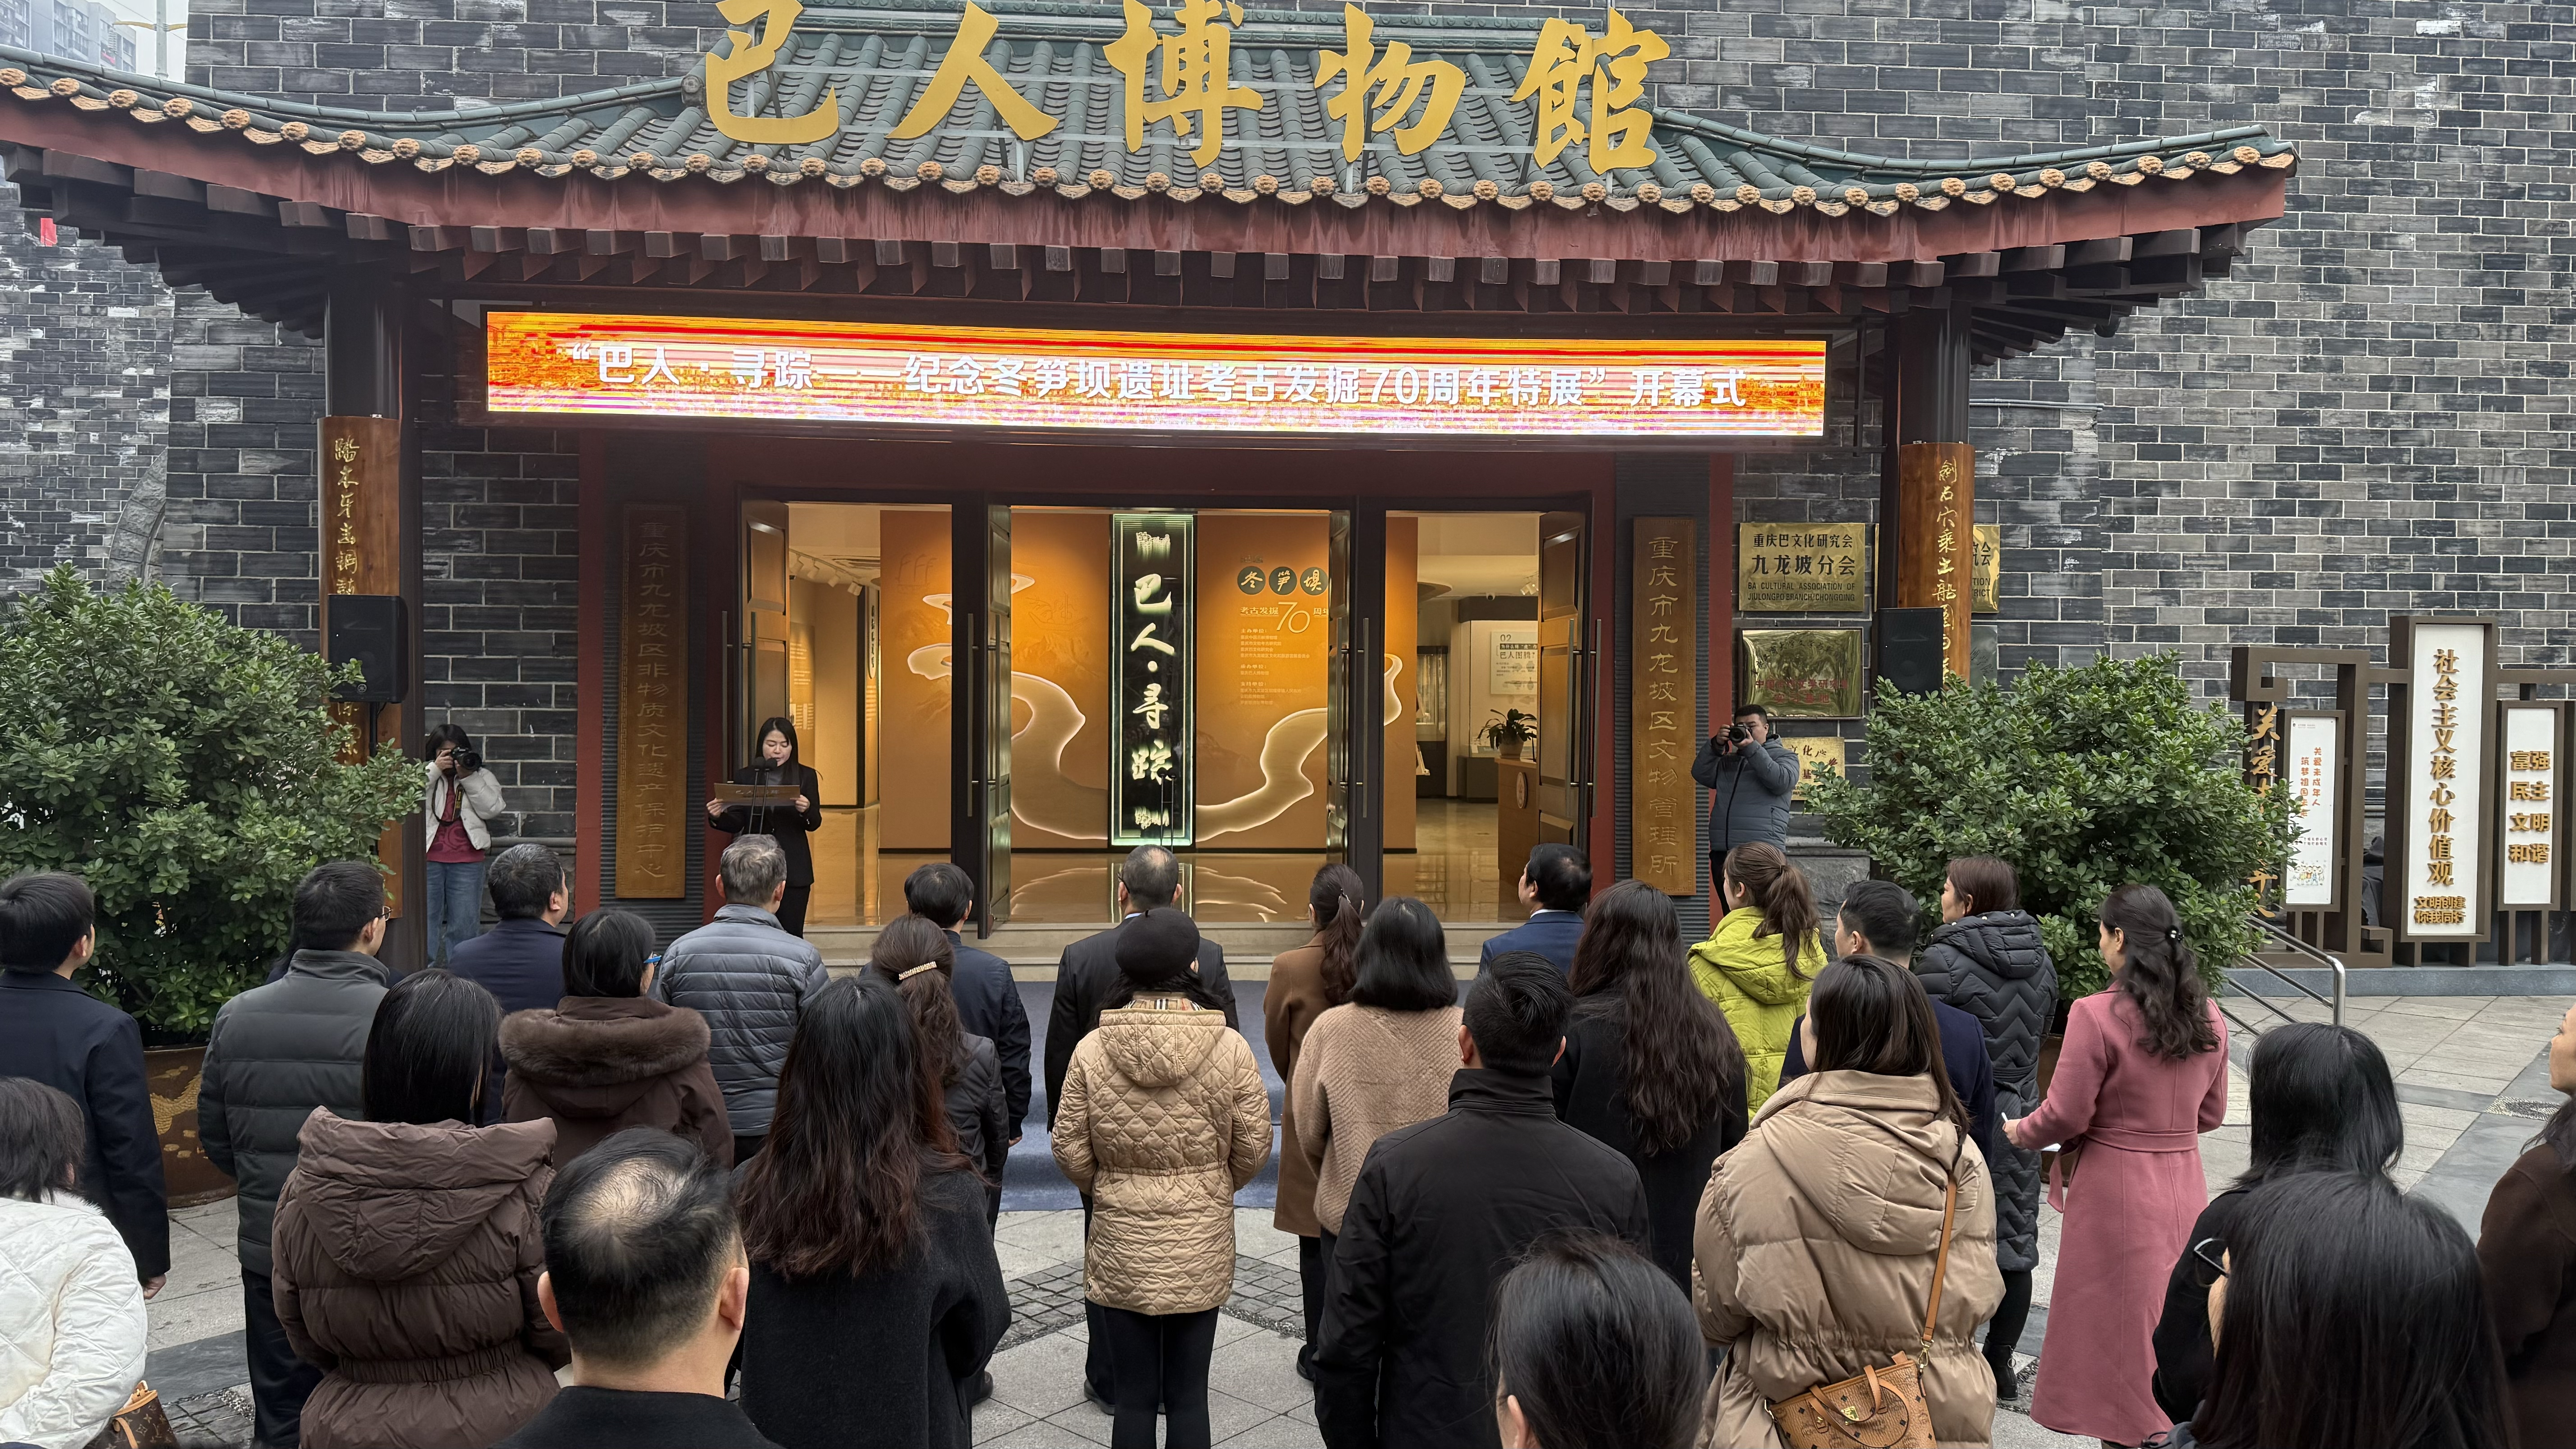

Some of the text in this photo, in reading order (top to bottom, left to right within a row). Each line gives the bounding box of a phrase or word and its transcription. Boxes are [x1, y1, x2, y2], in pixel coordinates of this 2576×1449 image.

[1753, 534, 1853, 548] 重庆巴文化研究会
[1752, 554, 1855, 575] 九龙坡分会
[1799, 582, 1842, 590] ASSOCIATION
[1648, 537, 1679, 876] 重庆市九龙坡区文物管理所
[2427, 649, 2460, 887] 社会主义核心价值观
[2510, 750, 2551, 771] 富强
[2312, 747, 2322, 806] 关爱未成年人
[2510, 781, 2551, 802] 民主
[2509, 812, 2550, 833] 文明
[2508, 843, 2550, 864] 和谐
[2414, 896, 2466, 909] 文明创建
[2414, 910, 2466, 924] 你我同行
